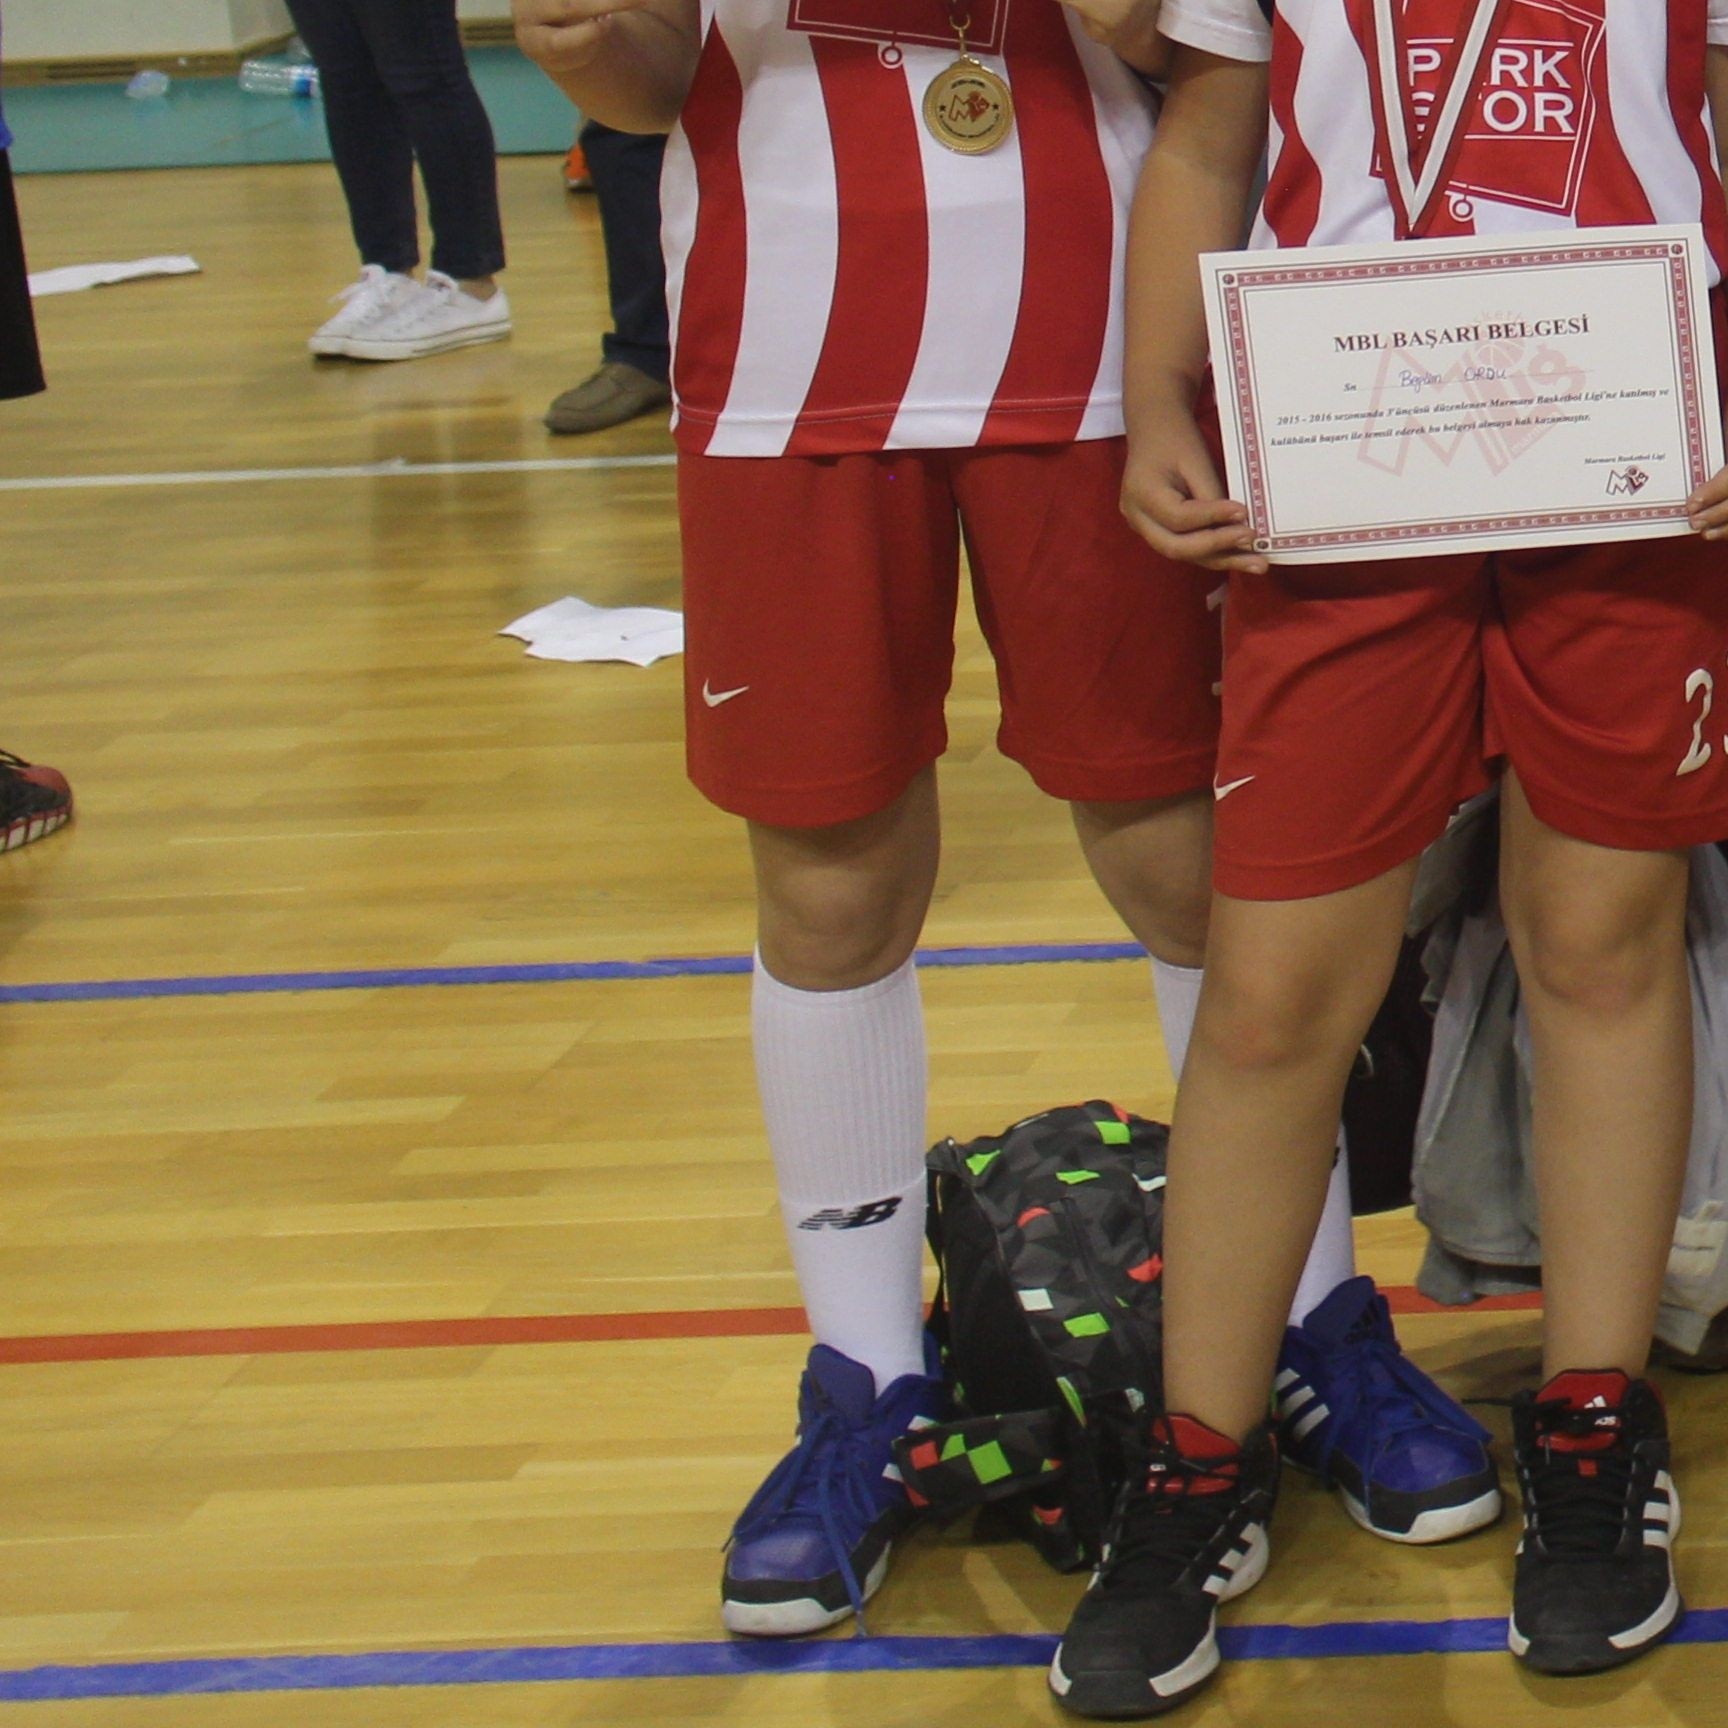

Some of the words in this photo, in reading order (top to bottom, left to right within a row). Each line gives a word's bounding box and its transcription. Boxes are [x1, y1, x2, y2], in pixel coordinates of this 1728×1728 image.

[1405, 47, 1572, 91] PRK
[1333, 335, 1389, 354] MBL
[1393, 326, 1480, 350] BAŞARI
[1487, 313, 1591, 341] BELGESİ
[1276, 415, 1301, 426] 2015
[1308, 413, 1333, 424] 2016
[1489, 396, 1534, 408] Marmara
[1536, 391, 1582, 405] Basketbol
